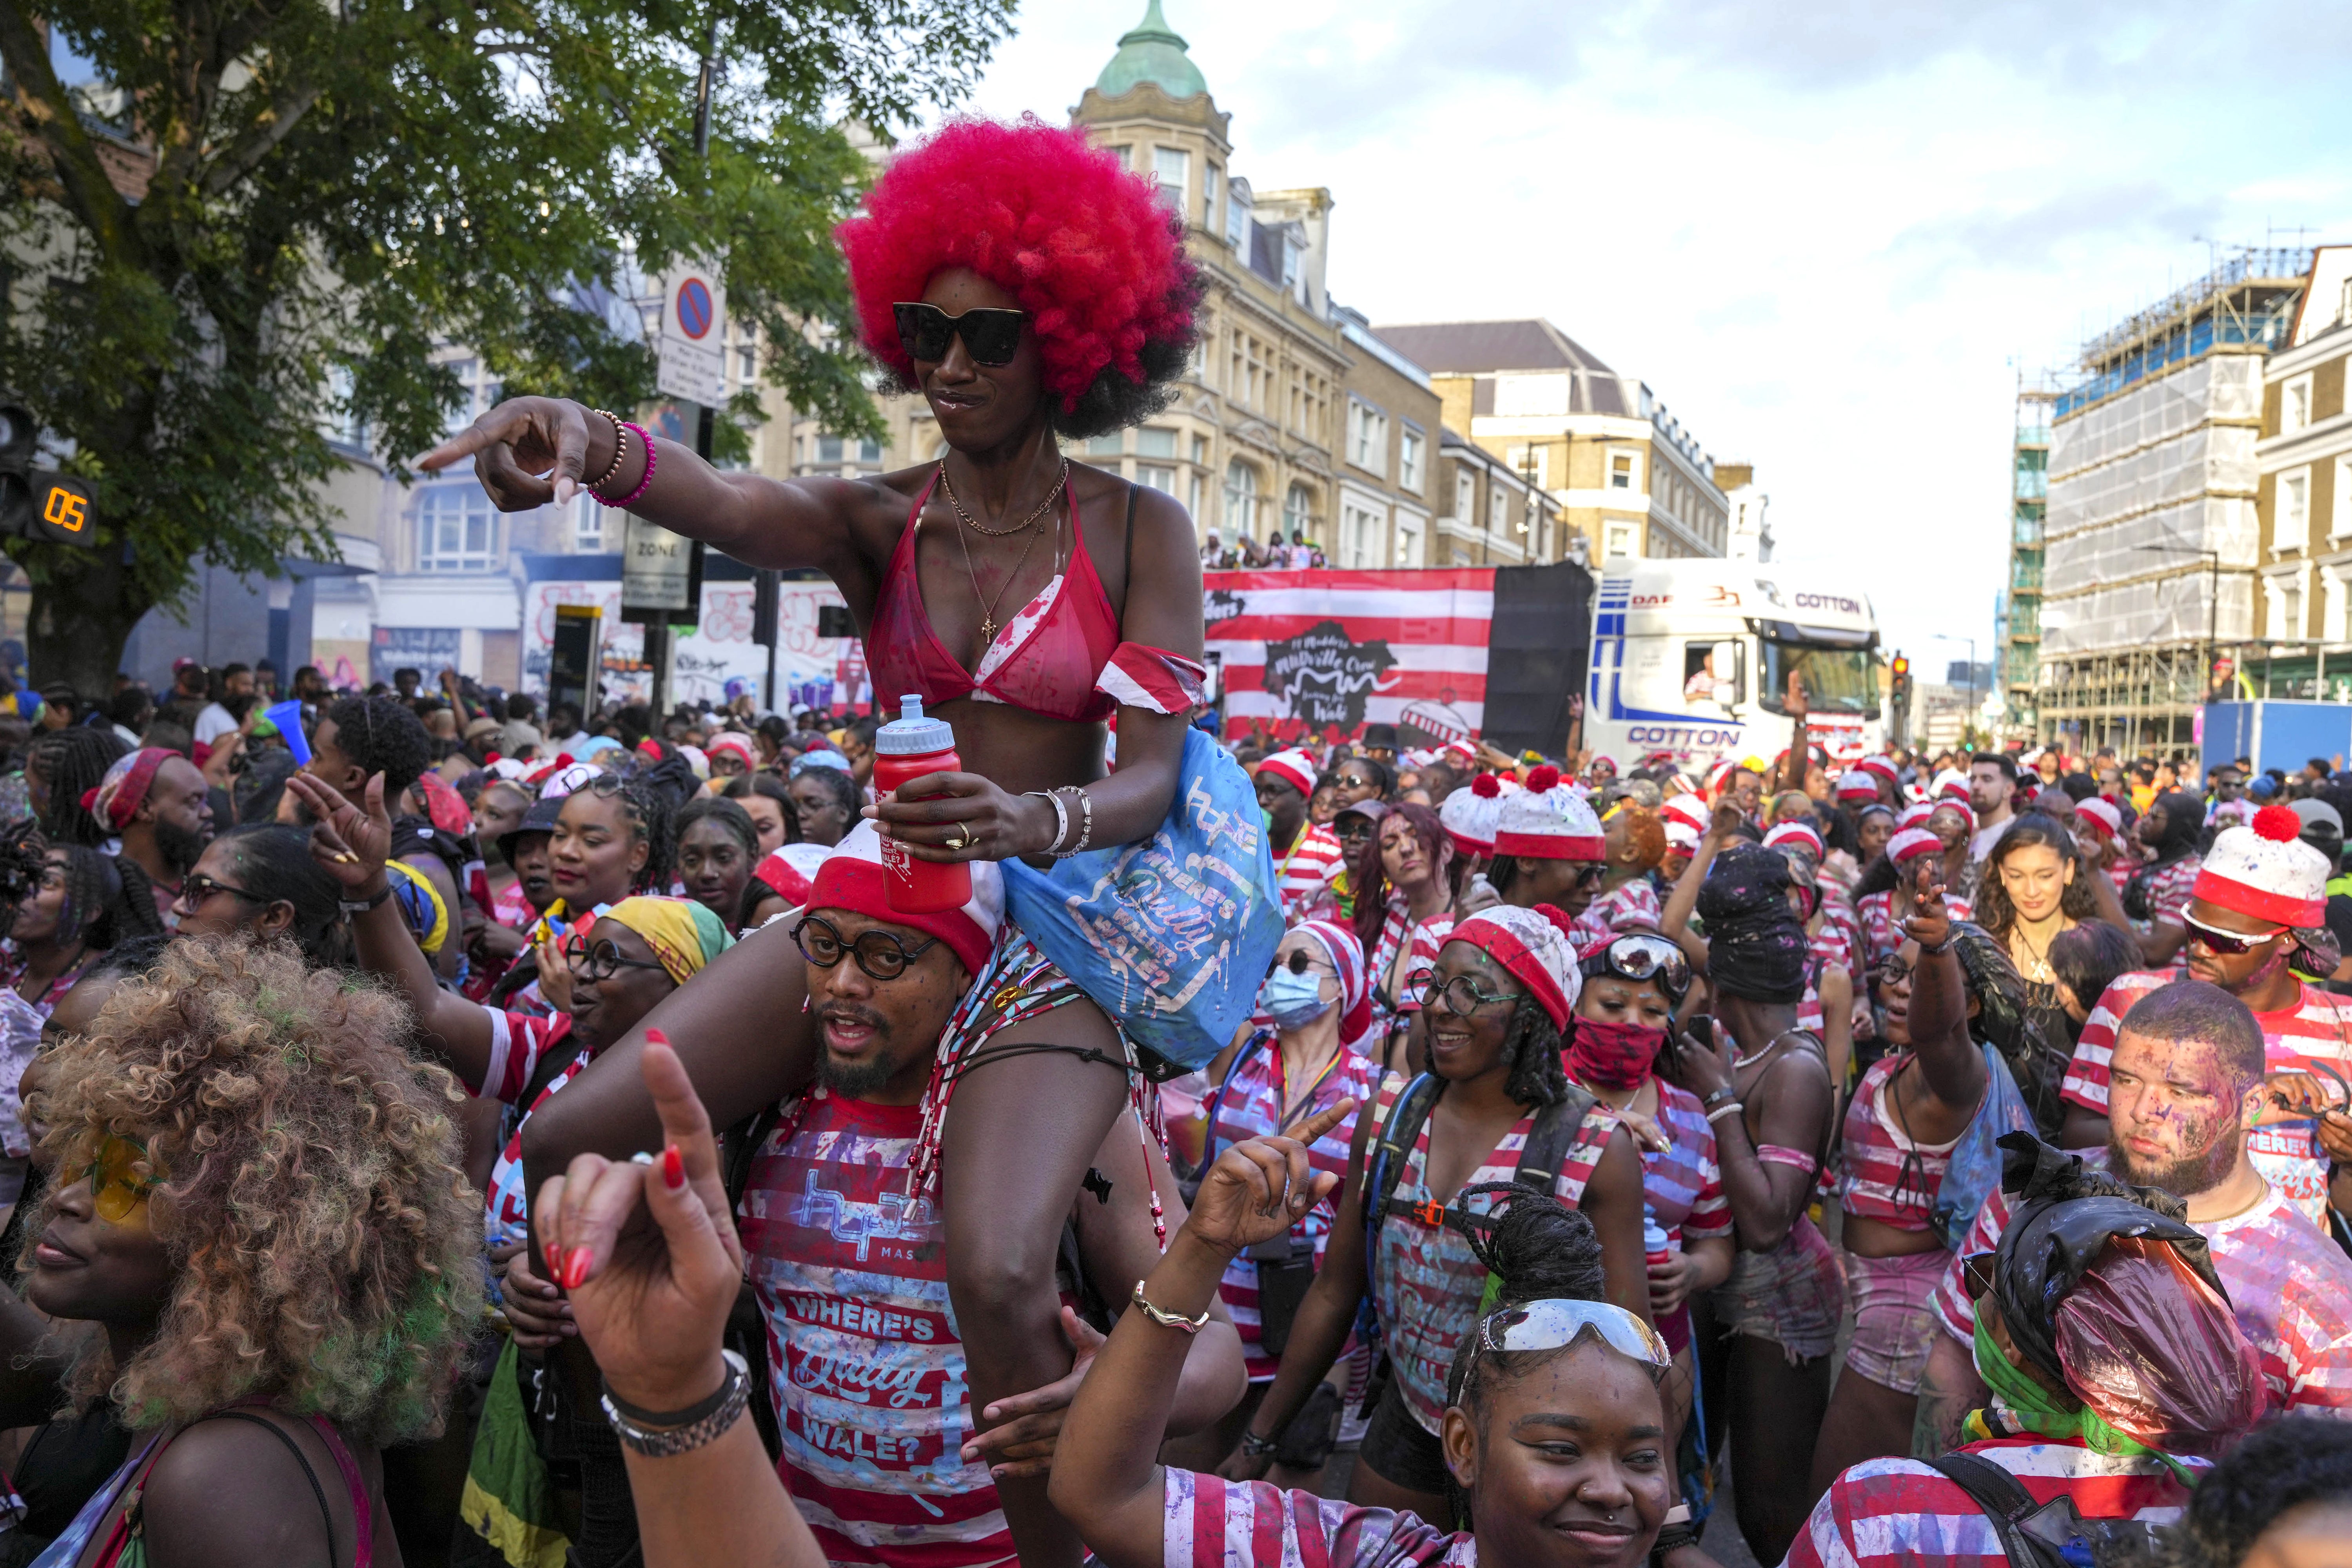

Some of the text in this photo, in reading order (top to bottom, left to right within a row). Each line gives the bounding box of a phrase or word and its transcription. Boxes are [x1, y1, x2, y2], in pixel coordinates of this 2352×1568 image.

[44, 487, 87, 532] 05
[637, 542, 678, 557] ZONE
[1632, 595, 1674, 604] DAF
[1796, 593, 1860, 614] COTTON
[1628, 726, 1740, 747] COTTON
[1224, 843, 1243, 862] MAS
[1142, 851, 1237, 920] WHERE'S
[881, 1247, 914, 1260] MAS
[788, 1296, 935, 1341] WHERE'S
